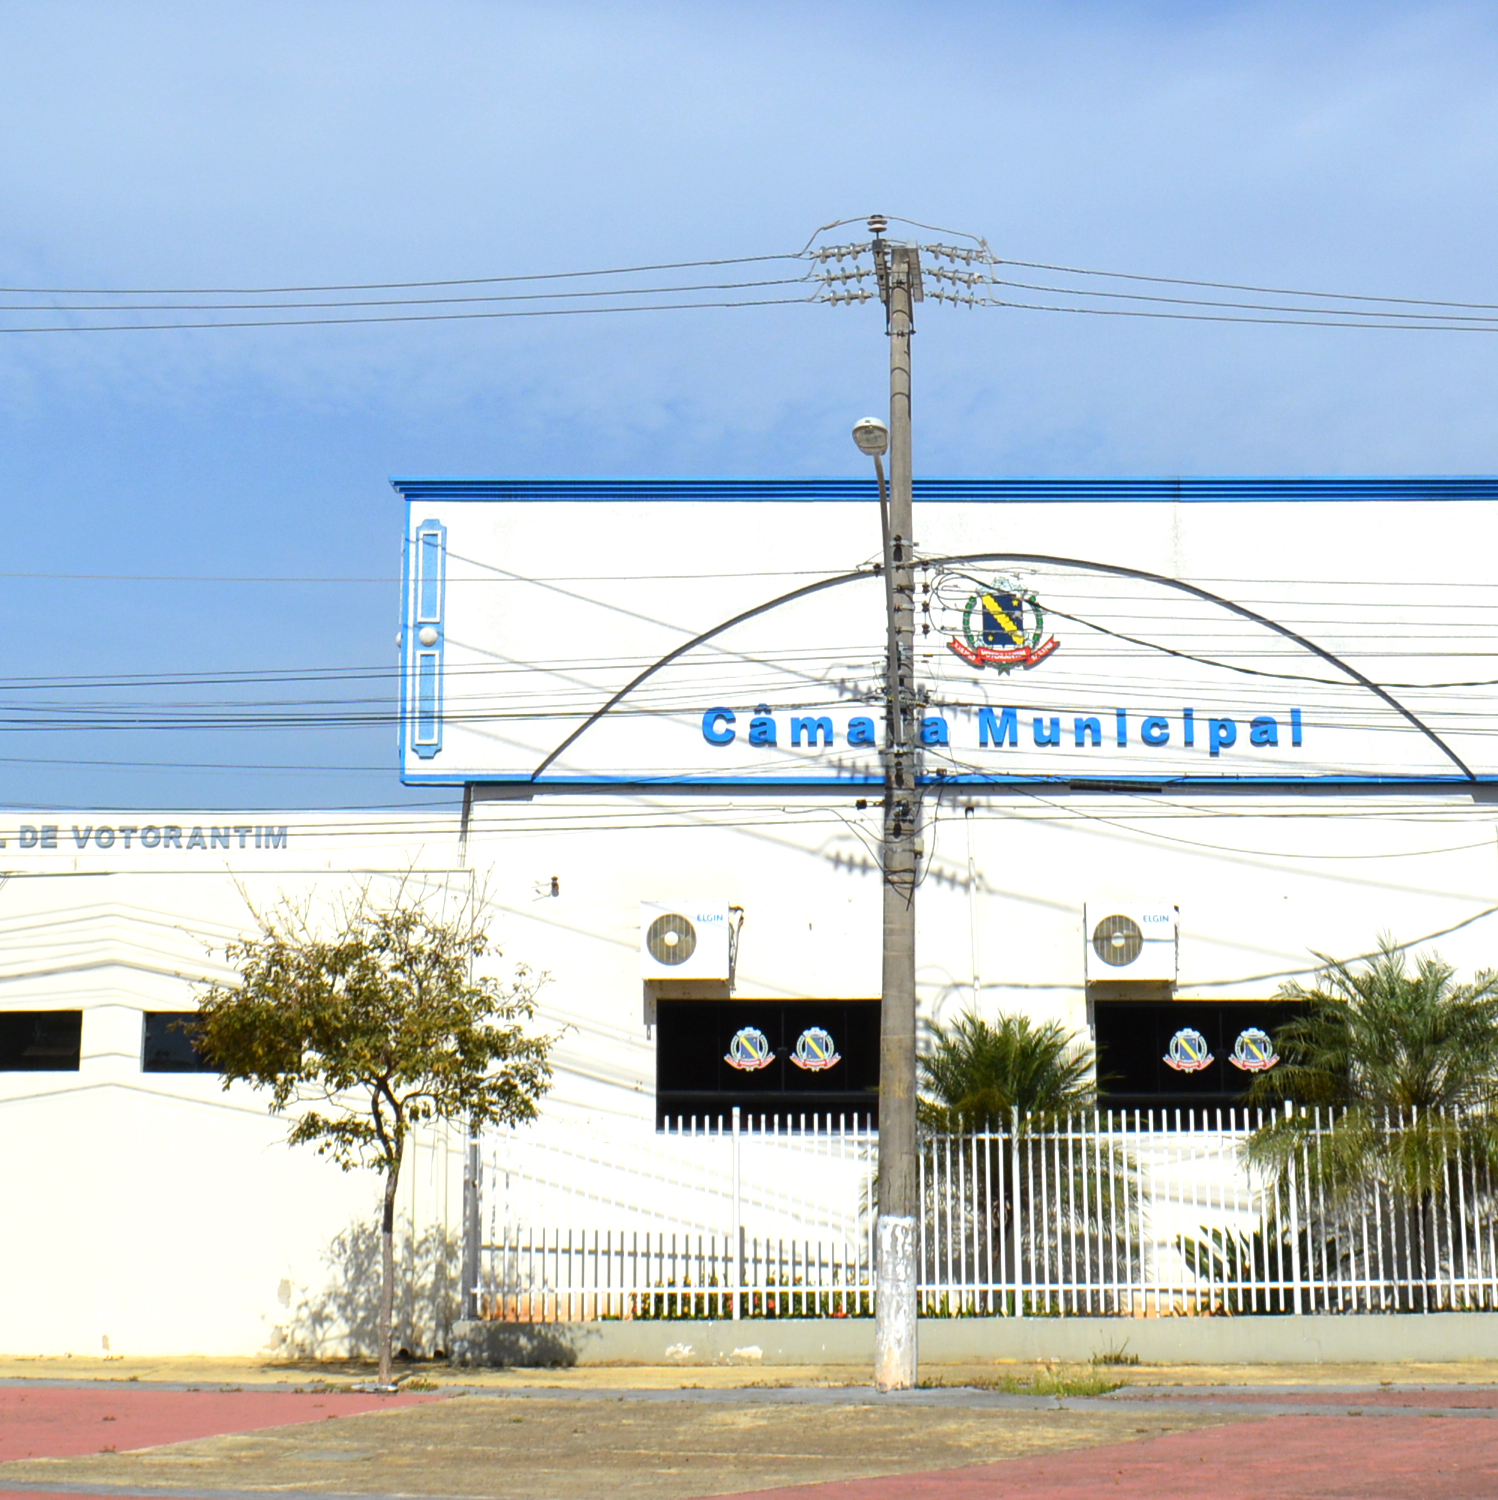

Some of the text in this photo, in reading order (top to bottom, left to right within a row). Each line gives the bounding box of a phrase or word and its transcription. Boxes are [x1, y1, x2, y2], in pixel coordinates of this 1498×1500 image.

[702, 703, 1302, 757] Câmaa Municipal
[19, 825, 59, 849] DE
[71, 825, 288, 849] VOTORANTIM
[696, 913, 723, 922] ELGIN
[1142, 914, 1169, 923] ELGIN
